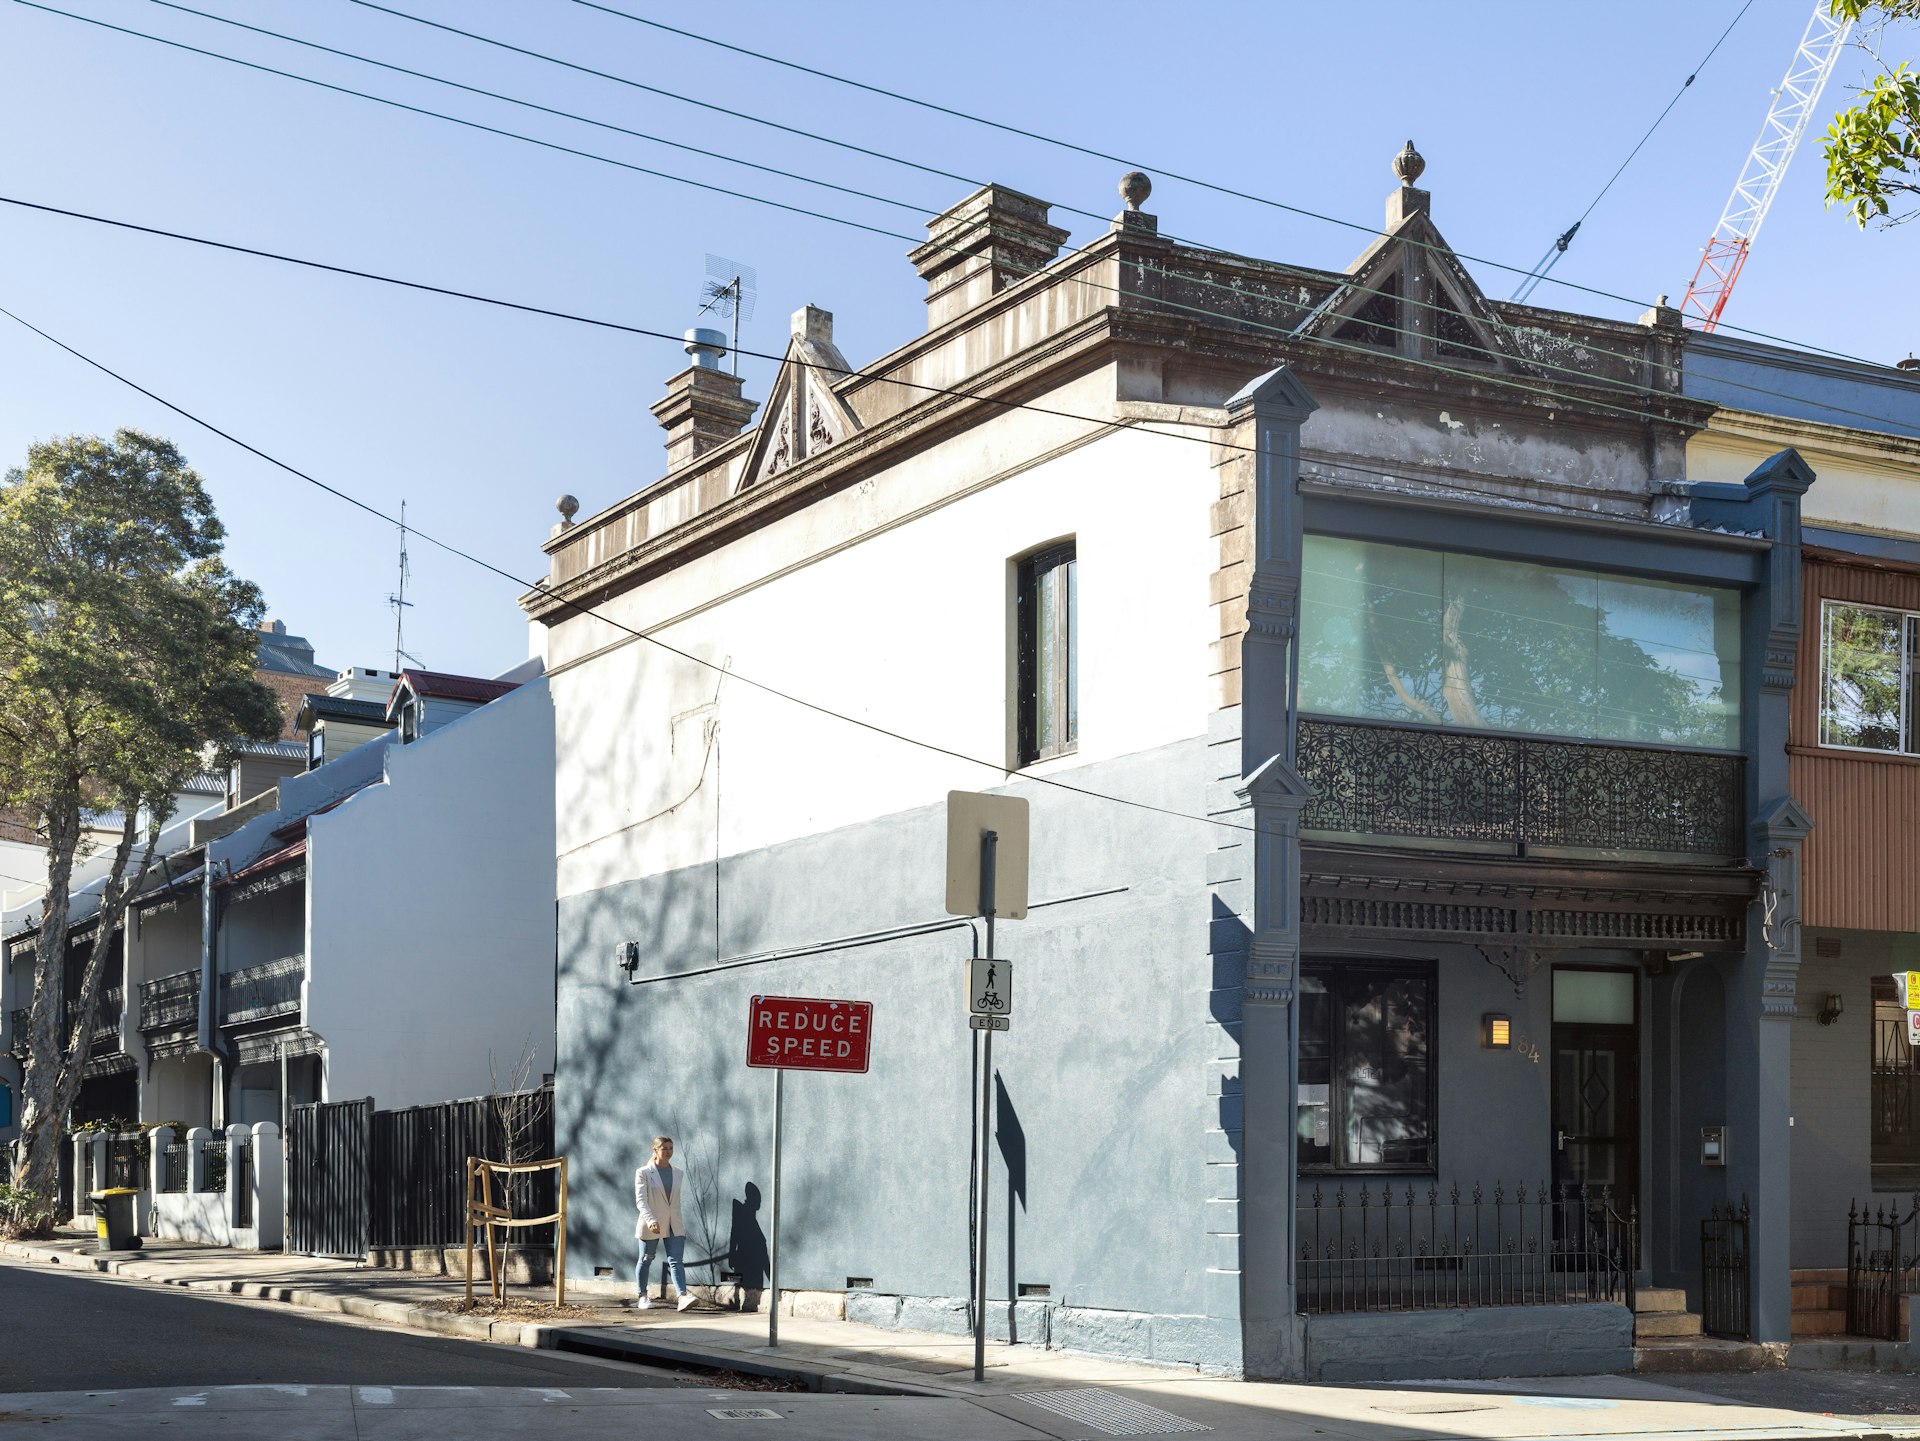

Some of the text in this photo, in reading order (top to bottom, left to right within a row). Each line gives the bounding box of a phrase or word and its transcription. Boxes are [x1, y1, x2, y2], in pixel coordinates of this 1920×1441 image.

[759, 1010, 861, 1033] REDUCE
[979, 1018, 1001, 1028] END
[766, 1036, 851, 1058] SPEED
[1517, 1034, 1541, 1064] 84
